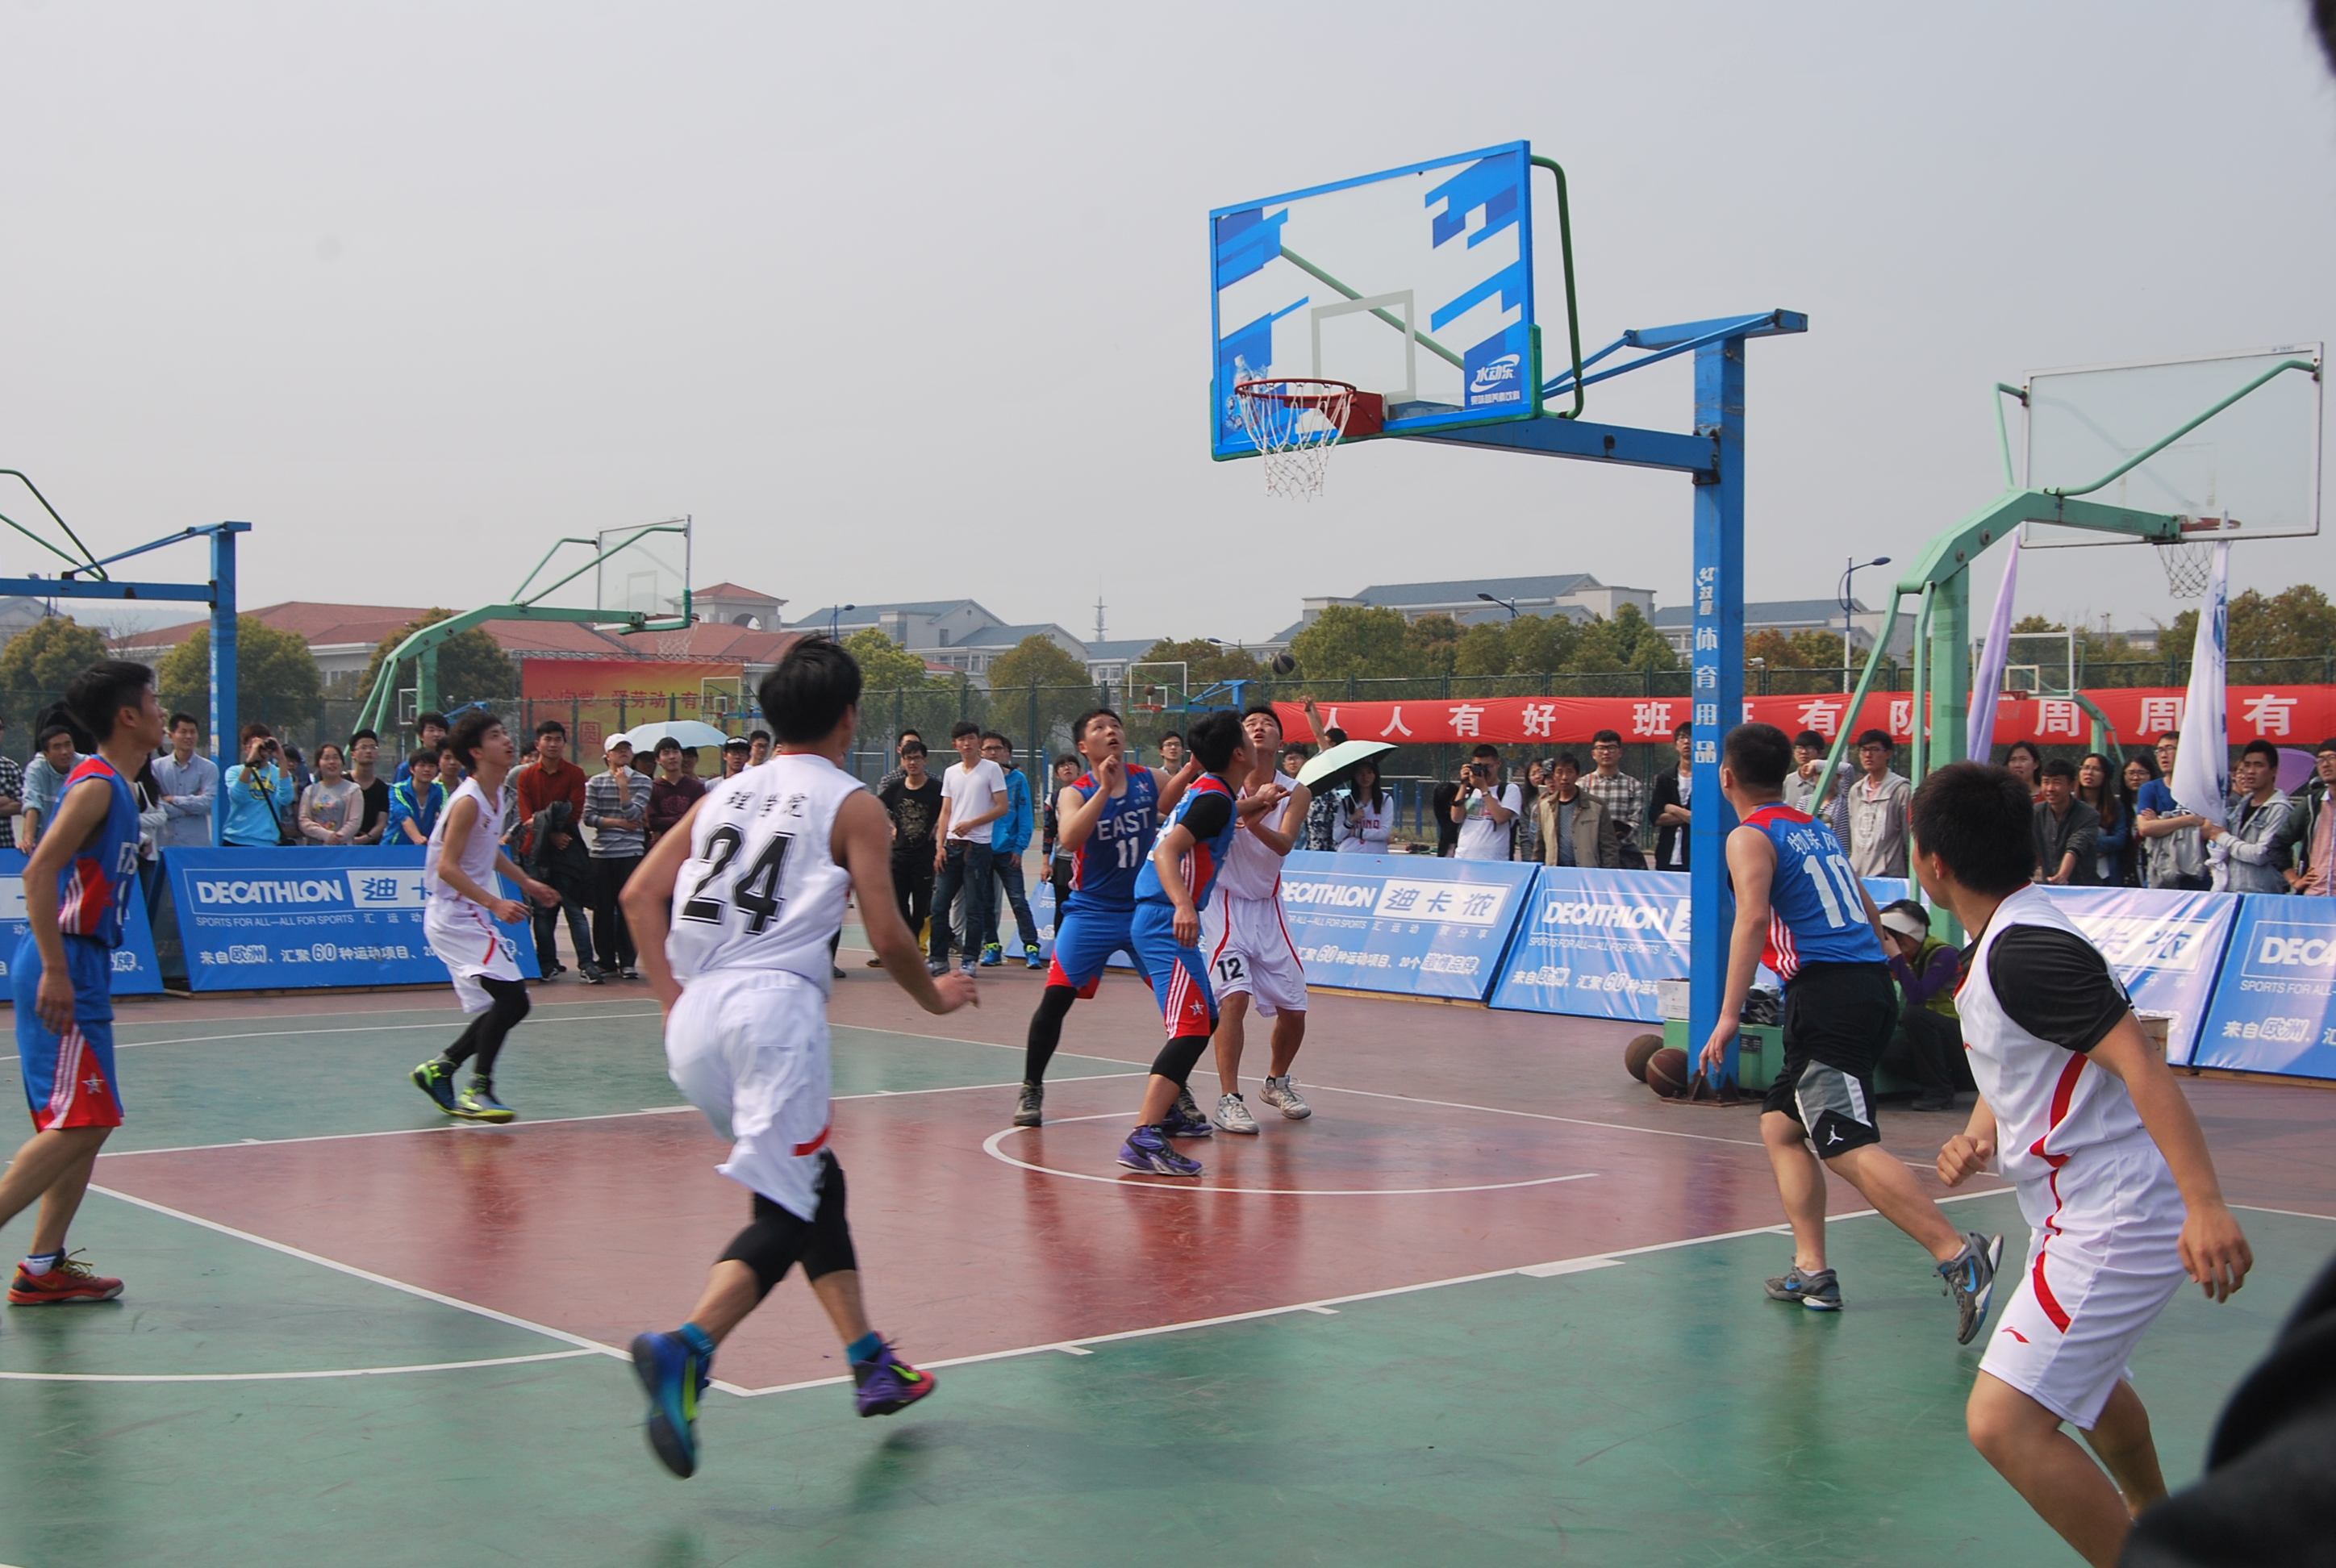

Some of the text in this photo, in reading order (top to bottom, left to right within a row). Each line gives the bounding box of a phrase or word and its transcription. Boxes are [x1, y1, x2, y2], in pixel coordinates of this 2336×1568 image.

[1475, 363, 1514, 382] 水动乐
[611, 690, 666, 708] 爱劳动
[1695, 627, 1718, 764] 体育用品
[1096, 807, 1151, 841] EAST
[1115, 836, 1140, 869] 11
[1787, 828, 1842, 855] 物联网
[116, 841, 139, 875] EAS
[196, 877, 433, 904] DECATHLON 迪卡
[677, 822, 797, 936] 24
[1803, 854, 1869, 928] 10
[1383, 888, 1495, 916] 迪卡侬
[196, 916, 232, 928] SPORTS
[233, 916, 253, 927] FOR
[298, 915, 317, 925] FOR
[318, 914, 354, 925] SPORTS
[1325, 918, 1341, 928] FOR
[1340, 919, 1367, 929] SPORTS
[1542, 902, 1669, 930] DECATHLON
[1529, 937, 1559, 948] SPORTS
[1559, 938, 1575, 949] FOR
[1611, 941, 1628, 953] FOR
[1628, 943, 1660, 954] SPORTS
[1216, 957, 1245, 982] 12
[2240, 980, 2285, 993] SPORTS
[2287, 982, 2310, 995] FOR
